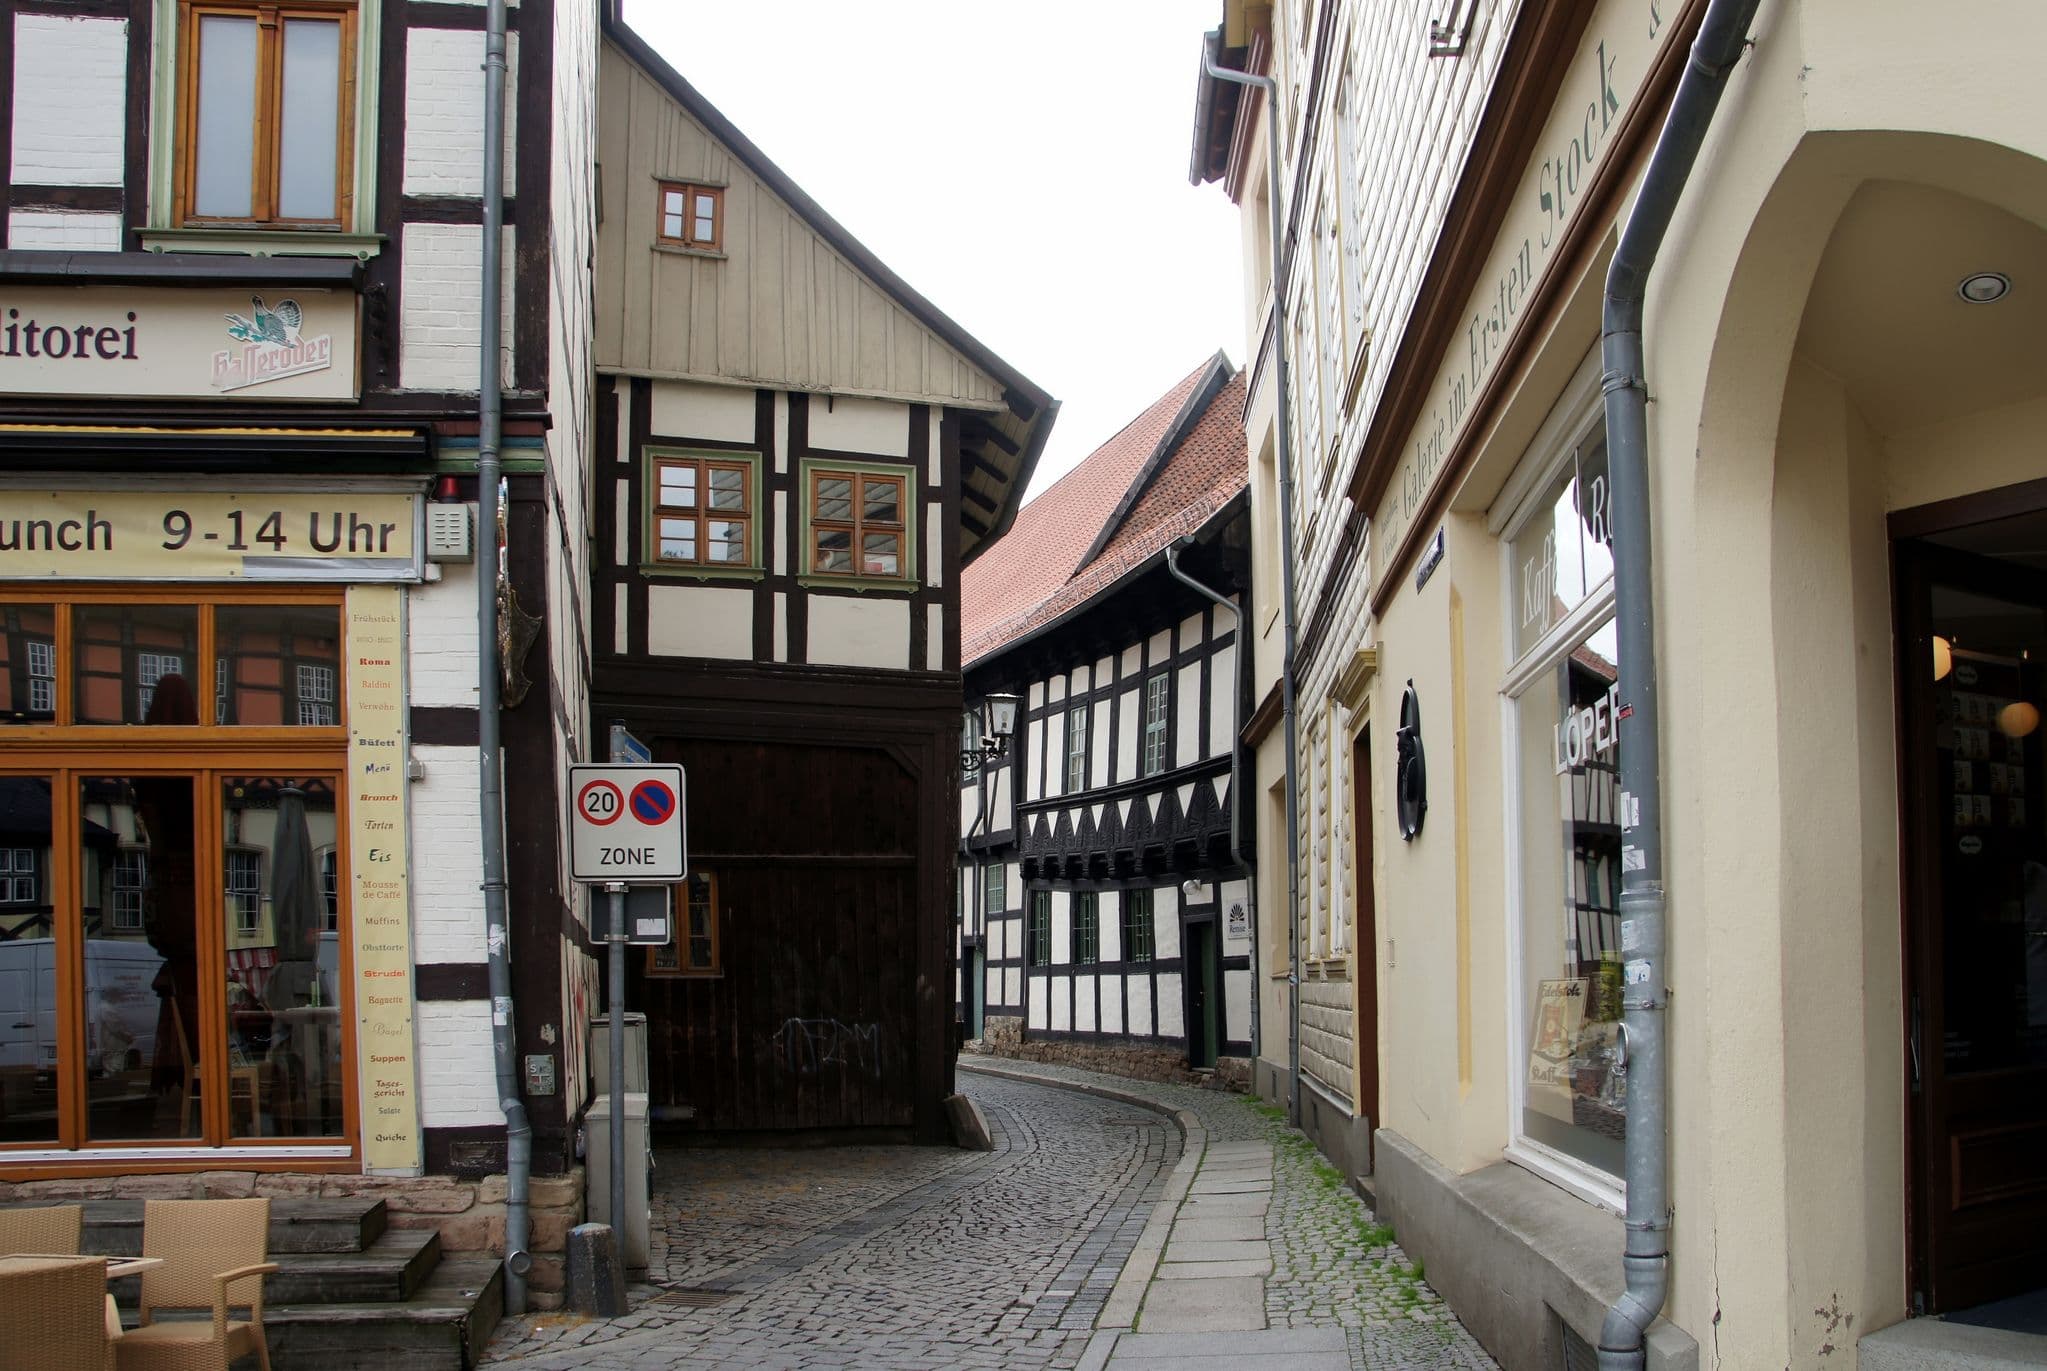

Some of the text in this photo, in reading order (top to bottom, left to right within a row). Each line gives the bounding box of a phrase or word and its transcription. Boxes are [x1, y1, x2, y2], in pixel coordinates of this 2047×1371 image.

[1403, 409, 1445, 520] Galerie
[1449, 375, 1466, 436] im
[1468, 239, 1532, 395] Ersten
[1539, 39, 1620, 256] Stock
[309, 511, 396, 553] Uhr
[353, 614, 397, 623] Frühstück
[359, 657, 391, 666] Roma
[359, 738, 396, 747] Büfett
[360, 794, 398, 802] Brunch
[588, 792, 614, 813] 20
[369, 848, 392, 863] Eis
[600, 848, 656, 865] ZONE
[362, 881, 399, 889] Mousse
[362, 891, 374, 899] de
[365, 917, 401, 926] Muffins
[362, 943, 405, 952] Obsttorte
[363, 970, 406, 978] Strudel
[370, 1055, 406, 1064] Suppen
[374, 1089, 405, 1098] gericht
[375, 1133, 407, 1142] Quiche
